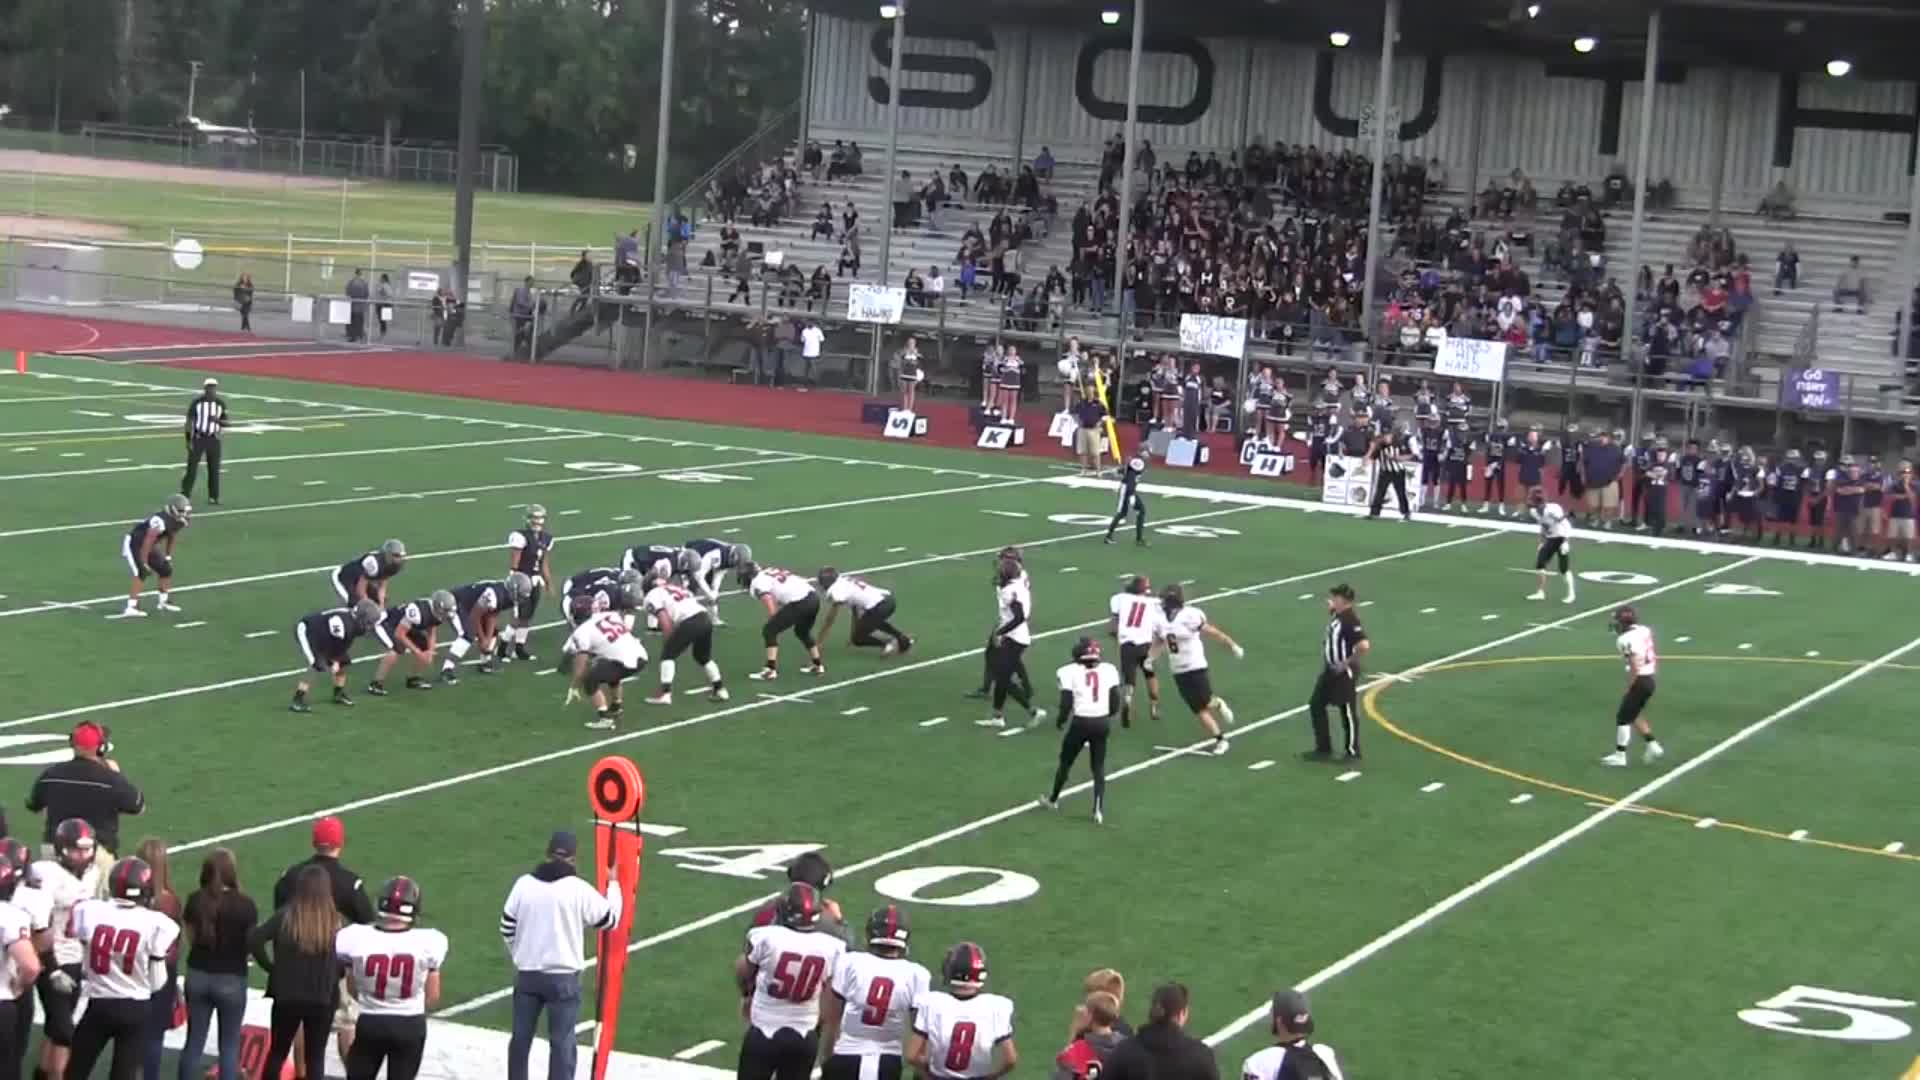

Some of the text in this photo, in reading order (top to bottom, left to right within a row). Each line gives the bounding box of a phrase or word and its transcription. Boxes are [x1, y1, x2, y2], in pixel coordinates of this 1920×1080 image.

[985, 431, 1002, 443] K
[1127, 601, 1146, 629] 11
[1085, 671, 1100, 703] 7
[90, 924, 141, 976] 87
[365, 953, 415, 1000] 77
[767, 951, 826, 1004] 50
[861, 976, 895, 1027] 9
[945, 1021, 976, 1072] 8
